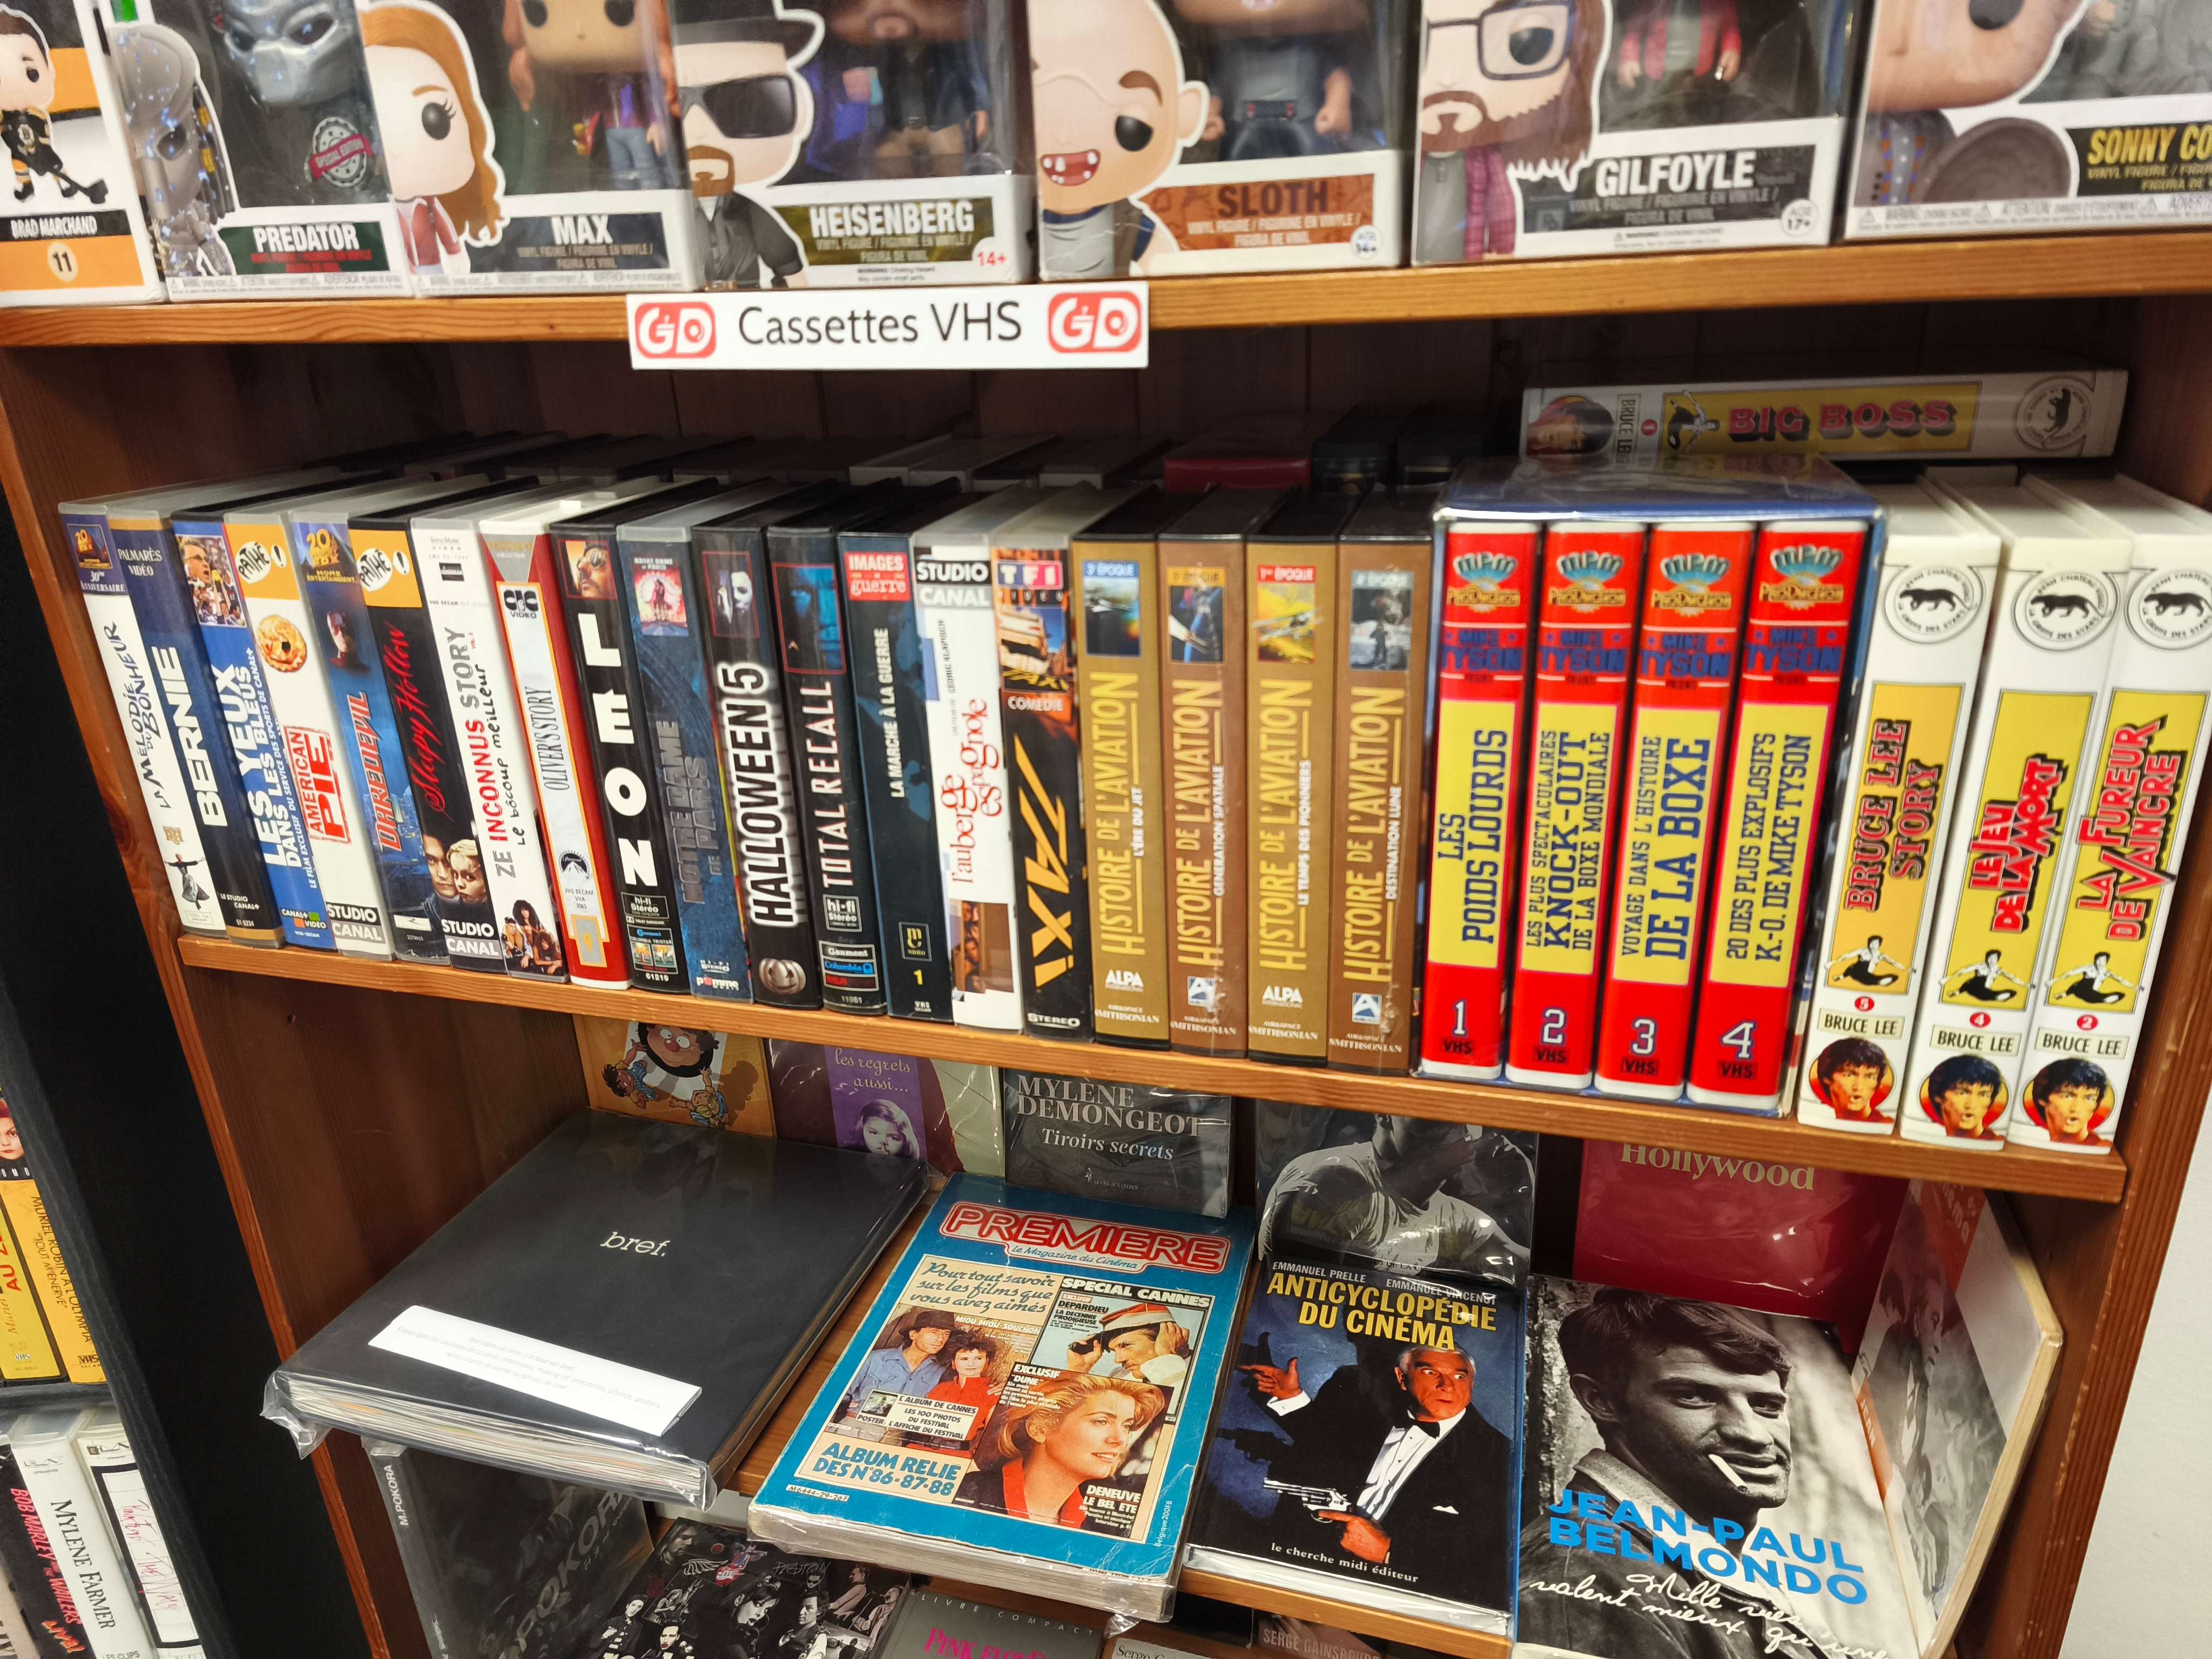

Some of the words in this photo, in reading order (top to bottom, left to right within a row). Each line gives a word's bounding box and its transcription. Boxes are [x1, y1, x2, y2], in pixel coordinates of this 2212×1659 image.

[2088, 126, 2176, 165] SONNY
[1596, 149, 1756, 197] GILFOYLE
[1218, 180, 1328, 217] SLOTH
[11, 217, 39, 238] BRAD
[40, 215, 98, 236] MARCHAND
[253, 222, 360, 252] PREDATOR
[551, 215, 612, 244] MAX
[810, 200, 975, 238] HEISENBERG
[52, 251, 72, 273] 11
[977, 251, 1007, 267] 14+
[738, 306, 918, 345] Cassettes
[930, 300, 1022, 341] VHS
[1729, 404, 1809, 443] BIG
[1819, 397, 1957, 440] BOSS
[118, 547, 162, 563] PALMARÈS
[848, 554, 904, 571] IMAGES
[916, 562, 989, 582] STUDIO
[80, 579, 125, 592] ANNIVERSAIRE
[920, 587, 991, 606] CANAL
[444, 627, 480, 709] STORY
[873, 628, 894, 684] GUERRE
[717, 660, 770, 694] 5
[879, 686, 895, 704] LA
[211, 664, 263, 777] YEUX
[236, 666, 269, 745] BLEUS
[151, 646, 228, 827] BERNIE
[799, 680, 842, 794] RECALL
[883, 720, 903, 778] MARCHE
[1089, 671, 1139, 813] L'AVIATION
[1171, 678, 1224, 824] L'AVIATION
[1259, 678, 1313, 825] L'AVIATION
[1865, 718, 1911, 787] LEE
[260, 752, 284, 797] LES
[347, 691, 403, 852] DAREDEVIL
[1347, 686, 1405, 834] L'AVIATION
[288, 731, 323, 834] AMERICAN
[304, 733, 345, 838] PIE
[466, 719, 509, 842] INCONNUS
[891, 778, 906, 798] LA
[1467, 730, 1507, 852] LOURDS
[1532, 730, 1556, 868] SPECTACULAIRES
[1583, 732, 1610, 833] MONDIALE
[1634, 736, 1661, 833] L'HISTOIRE
[1657, 738, 1711, 838] BOXE
[1741, 733, 1776, 839] EXPLOSIFS
[2078, 714, 2168, 847] FUREUR
[252, 790, 288, 866] LES
[720, 697, 798, 928] HALLOWEEN
[1095, 817, 1122, 841] DE
[1890, 760, 1943, 881] STORY
[2100, 751, 2189, 898] VAINCRE
[272, 804, 302, 867] DANS
[814, 803, 855, 888] TOTAL
[1175, 827, 1201, 851] DE
[1259, 830, 1285, 854] DE
[1346, 839, 1374, 863] DE
[1438, 813, 1466, 861] LES
[1544, 731, 1586, 949] KNOCK-OUT
[1845, 797, 1893, 912] BRUCE
[493, 850, 516, 878] ZE
[1577, 841, 1601, 887] BOXE
[1628, 840, 1650, 887] DANS
[1650, 853, 1697, 902] LA
[1734, 845, 1761, 894] PLUS
[1096, 846, 1146, 956] HISTOIRE
[1462, 860, 1499, 943] POIDS
[1529, 875, 1545, 914] PLUS
[1575, 897, 1595, 921] LA
[2076, 872, 2118, 911] LA
[281, 908, 308, 920] CANAL+
[327, 903, 377, 922] STUDIO
[333, 922, 382, 941] CANAL
[442, 919, 494, 937] STUDIO
[1176, 857, 1225, 967] HISTOIRE
[1259, 859, 1307, 971] HISTOIRE
[1343, 869, 1392, 983] HISTOIRE
[1622, 894, 1644, 956] VOYAGE
[1729, 899, 1754, 933] DES
[2106, 899, 2153, 941] DE
[446, 938, 500, 956] CANAL
[1526, 920, 1543, 947] LES
[1573, 929, 1592, 950] DE
[1645, 914, 1690, 960] DE
[1726, 938, 1749, 960] 20
[1453, 999, 1466, 1037] 1
[1542, 1008, 1566, 1046] 2
[1631, 1018, 1656, 1055] 3
[1824, 1014, 1869, 1034] BRUCE
[1874, 1019, 1898, 1036] LEE
[1443, 1040, 1473, 1055] VHS
[1536, 1048, 1566, 1063] VHS
[1721, 1021, 1755, 1059] 4
[1937, 1031, 1984, 1051] BRUCE
[1990, 1035, 2014, 1053] LEE
[2042, 1033, 2091, 1054] BRUCE
[2097, 1037, 2122, 1056] LEE
[835, 1048, 854, 1066] les
[859, 1056, 911, 1075] regrets
[1626, 1059, 1656, 1075] VHS
[1722, 1062, 1753, 1078] VHS
[1017, 1094, 1201, 1137] DEMONGEOT
[1042, 1127, 1105, 1151] Tiroirs
[1110, 1141, 1175, 1161] secrets
[1620, 1143, 1816, 1191] Hollywood
[599, 1231, 671, 1257] bref.
[942, 1203, 1228, 1272] PREMIERE
[2, 1264, 21, 1292] AU
[916, 1278, 943, 1290] sur
[945, 1279, 969, 1292] les
[966, 1279, 1019, 1299] films
[1020, 1289, 1053, 1305] que
[1061, 1278, 1132, 1297] SPECIAL
[1137, 1289, 1211, 1308] CANNES
[1272, 1262, 1327, 1278] EMMANUEL
[1330, 1269, 1367, 1284] PRELLE
[1386, 1278, 1442, 1297] EMMANUEL
[910, 1292, 950, 1304] vous
[953, 1297, 992, 1314] avez
[994, 1298, 1047, 1313] aimés
[1053, 1314, 1097, 1325] PRODIGIEUSE
[1058, 1300, 1109, 1313] DEPARDIEU
[1266, 1272, 1498, 1331] ANTICYCLOPÉDIE
[1299, 1301, 1338, 1329] DU
[1346, 1309, 1455, 1351] CINÉMA
[1014, 1364, 1061, 1379] EXCLUSIF
[899, 1394, 932, 1408] L'ALBUM
[933, 1401, 945, 1409] DE
[947, 1402, 976, 1414] CANNES
[822, 1441, 900, 1469] ALBUM
[900, 1457, 961, 1481] RELIE
[10, 1488, 35, 1513] BOB
[1086, 1485, 1142, 1503] DENEUVE
[21, 1513, 57, 1560] MARLEY
[1548, 1489, 1864, 1573] JEAN-PAUL
[50, 1499, 93, 1567] MYLENE
[79, 1571, 116, 1629] FARMER
[1271, 1542, 1282, 1553] le
[1286, 1545, 1334, 1564] cherche
[1339, 1559, 1367, 1571] midi
[1372, 1566, 1419, 1583] éditeur
[1548, 1516, 1868, 1606] BELMONDO
[1626, 1573, 1723, 1610] Mille
[921, 1593, 980, 1613] LIVRE
[998, 1610, 1094, 1637] COMPACT
[1263, 1628, 1299, 1651] SERGE
[1304, 1638, 1381, 1659] GAINSBOUR
